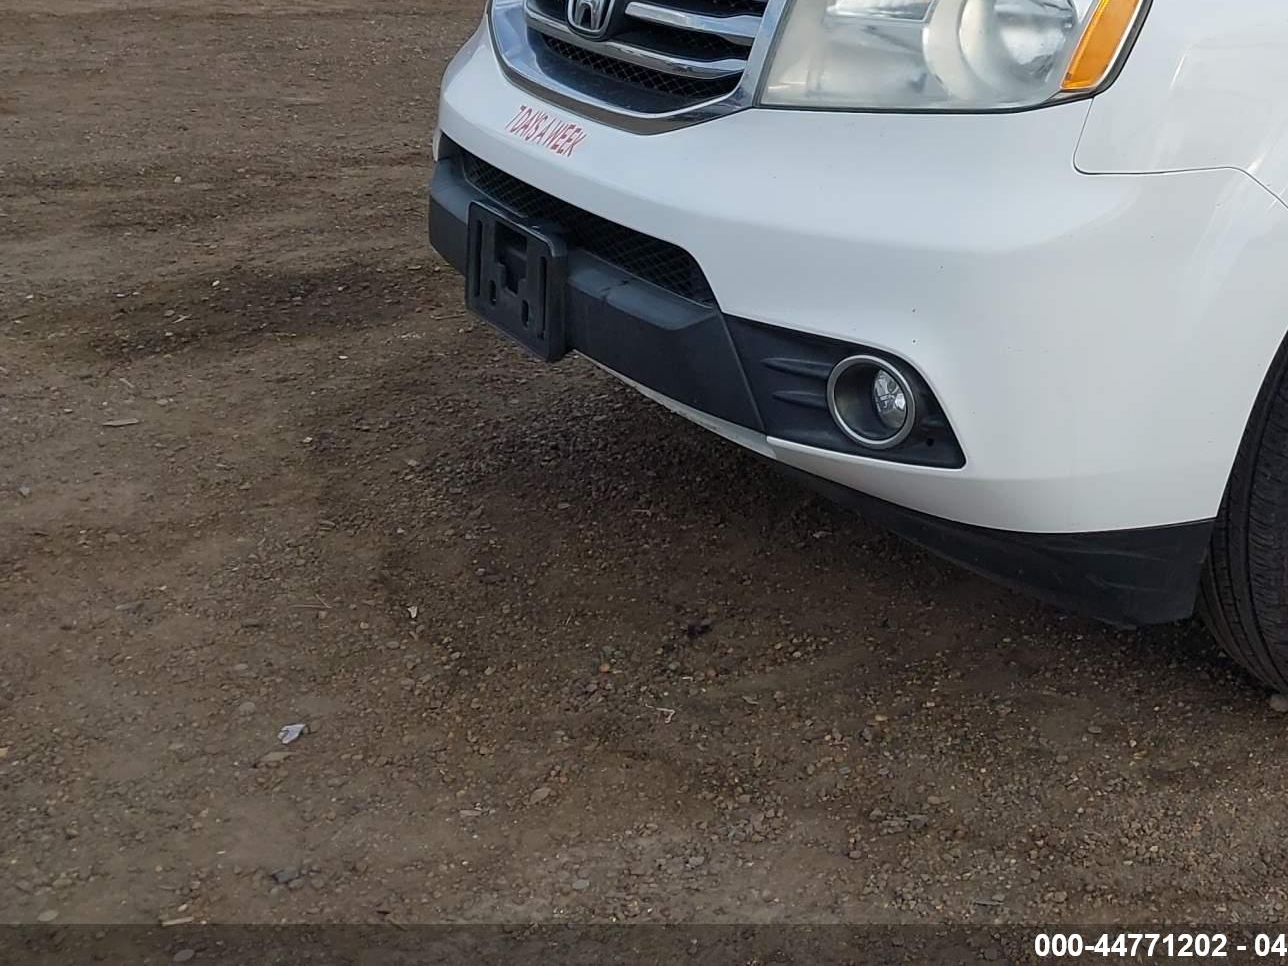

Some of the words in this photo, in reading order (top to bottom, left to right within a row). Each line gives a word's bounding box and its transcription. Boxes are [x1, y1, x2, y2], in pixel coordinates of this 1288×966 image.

[505, 104, 529, 130] 7
[510, 107, 549, 141] DAYS
[532, 117, 557, 145] A
[541, 120, 588, 158] WEEK
